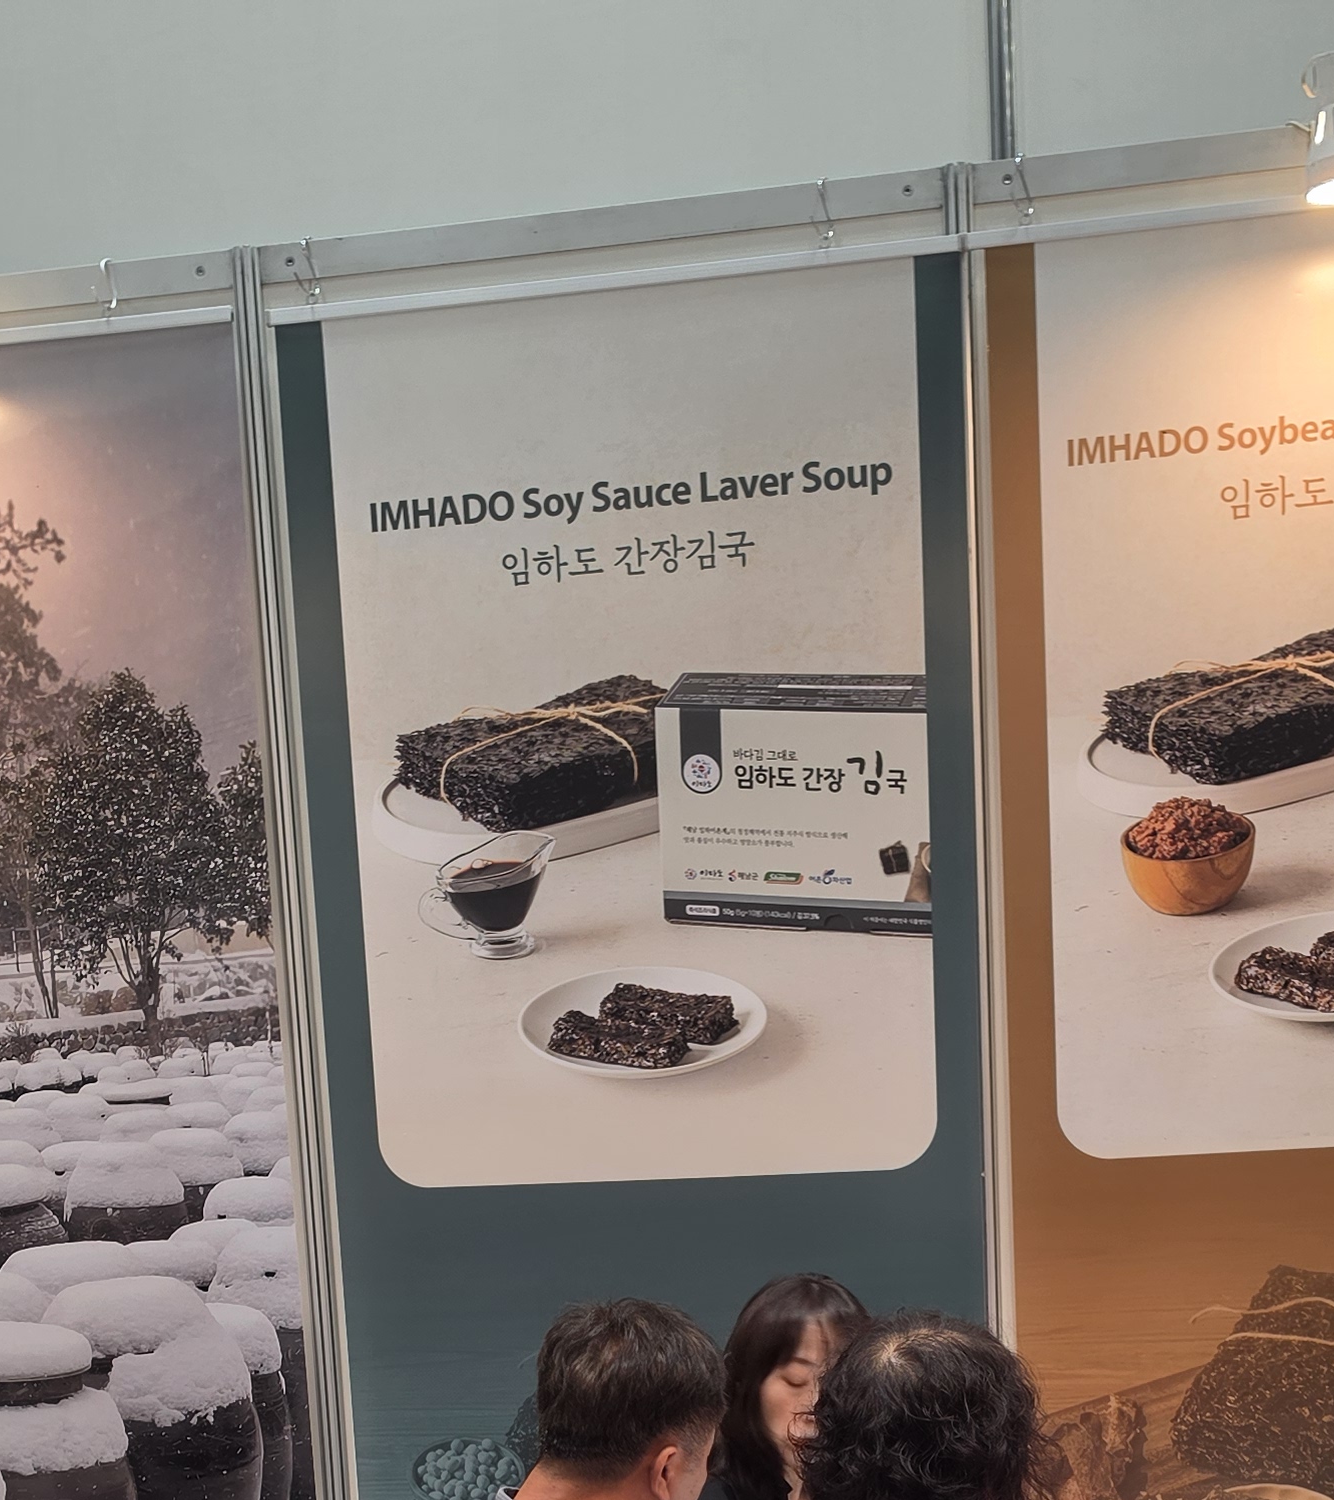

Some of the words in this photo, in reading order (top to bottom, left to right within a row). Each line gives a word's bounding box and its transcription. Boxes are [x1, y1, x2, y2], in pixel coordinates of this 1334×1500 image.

[1066, 425, 1209, 467] IMHADO
[370, 491, 515, 533] IMHADO
[523, 488, 583, 524] Soy
[592, 480, 691, 516] Sauce
[699, 461, 795, 503] Laver
[801, 458, 893, 495] Soup
[1220, 475, 1334, 520] 임하도
[502, 544, 605, 586] 임하도
[614, 530, 755, 576] 간장김국
[733, 749, 763, 761] 바다김
[766, 750, 798, 761] 그대로
[734, 765, 796, 789] 임하도
[803, 766, 845, 793] 간장
